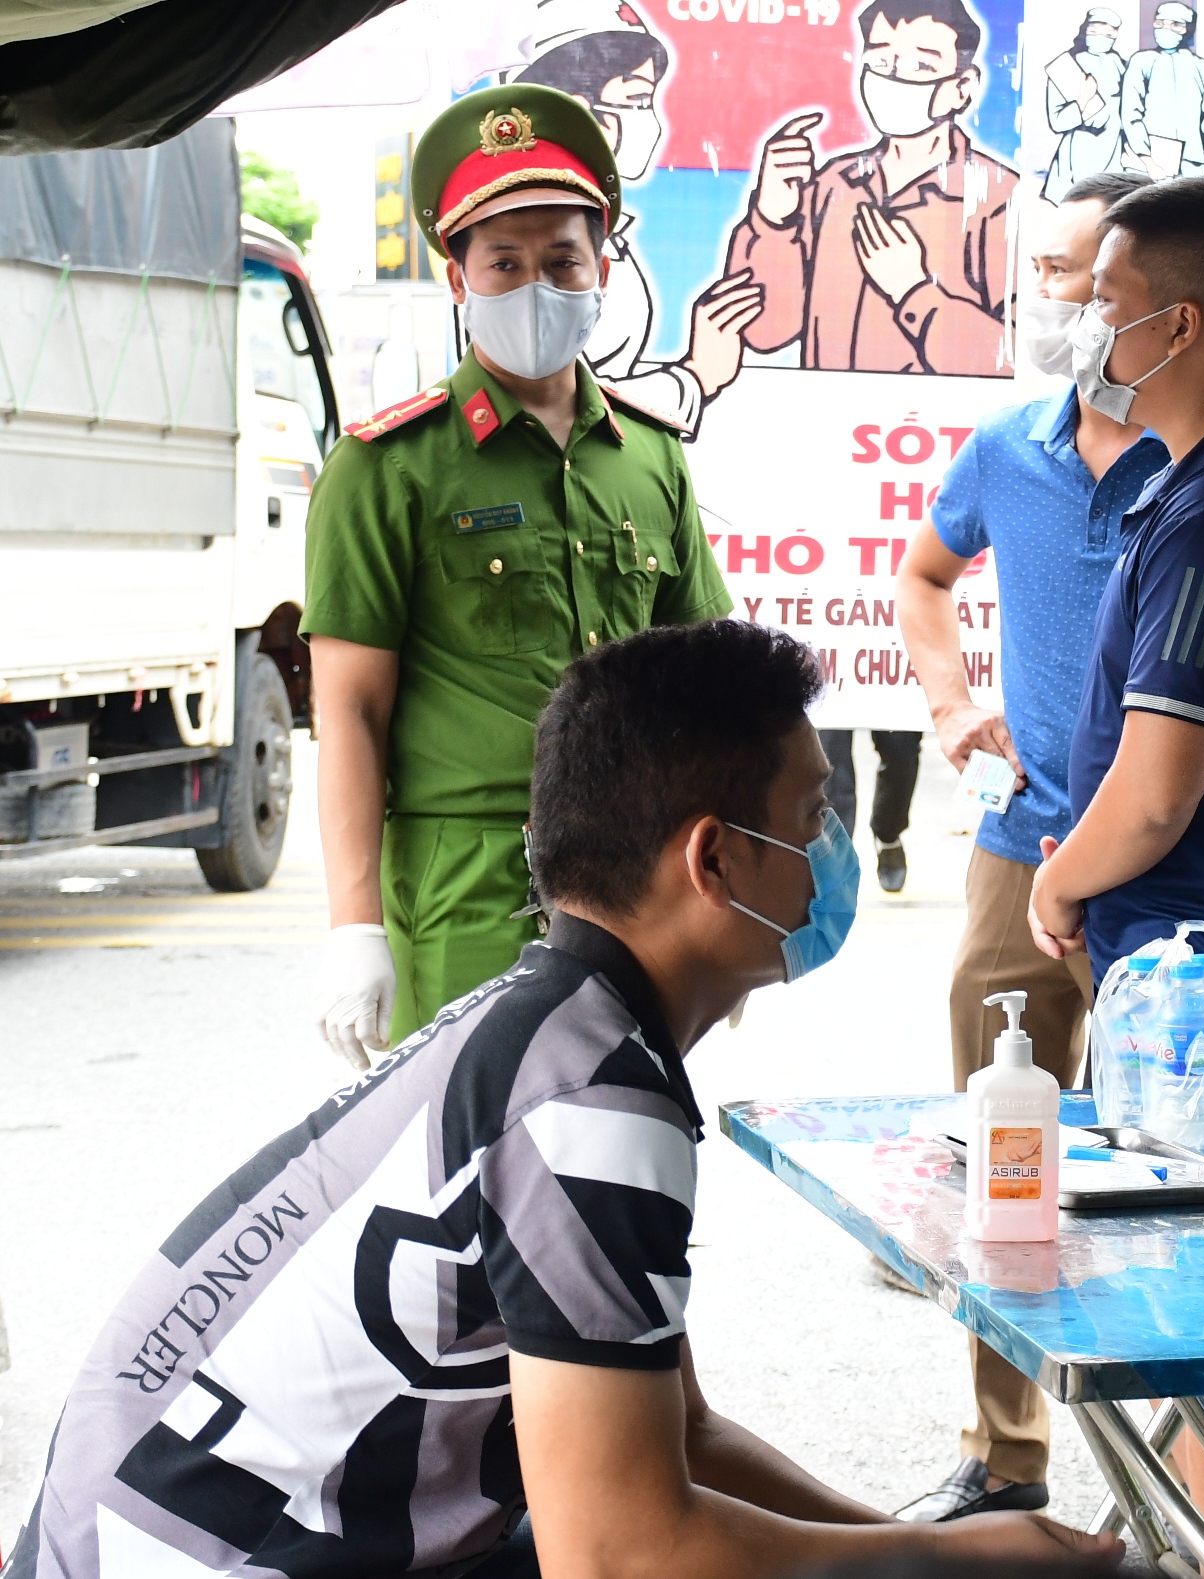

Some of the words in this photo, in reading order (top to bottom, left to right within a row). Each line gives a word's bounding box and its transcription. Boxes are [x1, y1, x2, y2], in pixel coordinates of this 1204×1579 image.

[667, 0, 840, 26] COVID-19
[775, 588, 813, 625] TẾ
[825, 589, 894, 627] GẦN
[957, 591, 996, 629] ẤT
[991, 1167, 1039, 1178] ASIRUB
[115, 1190, 309, 1394] MONCLER
